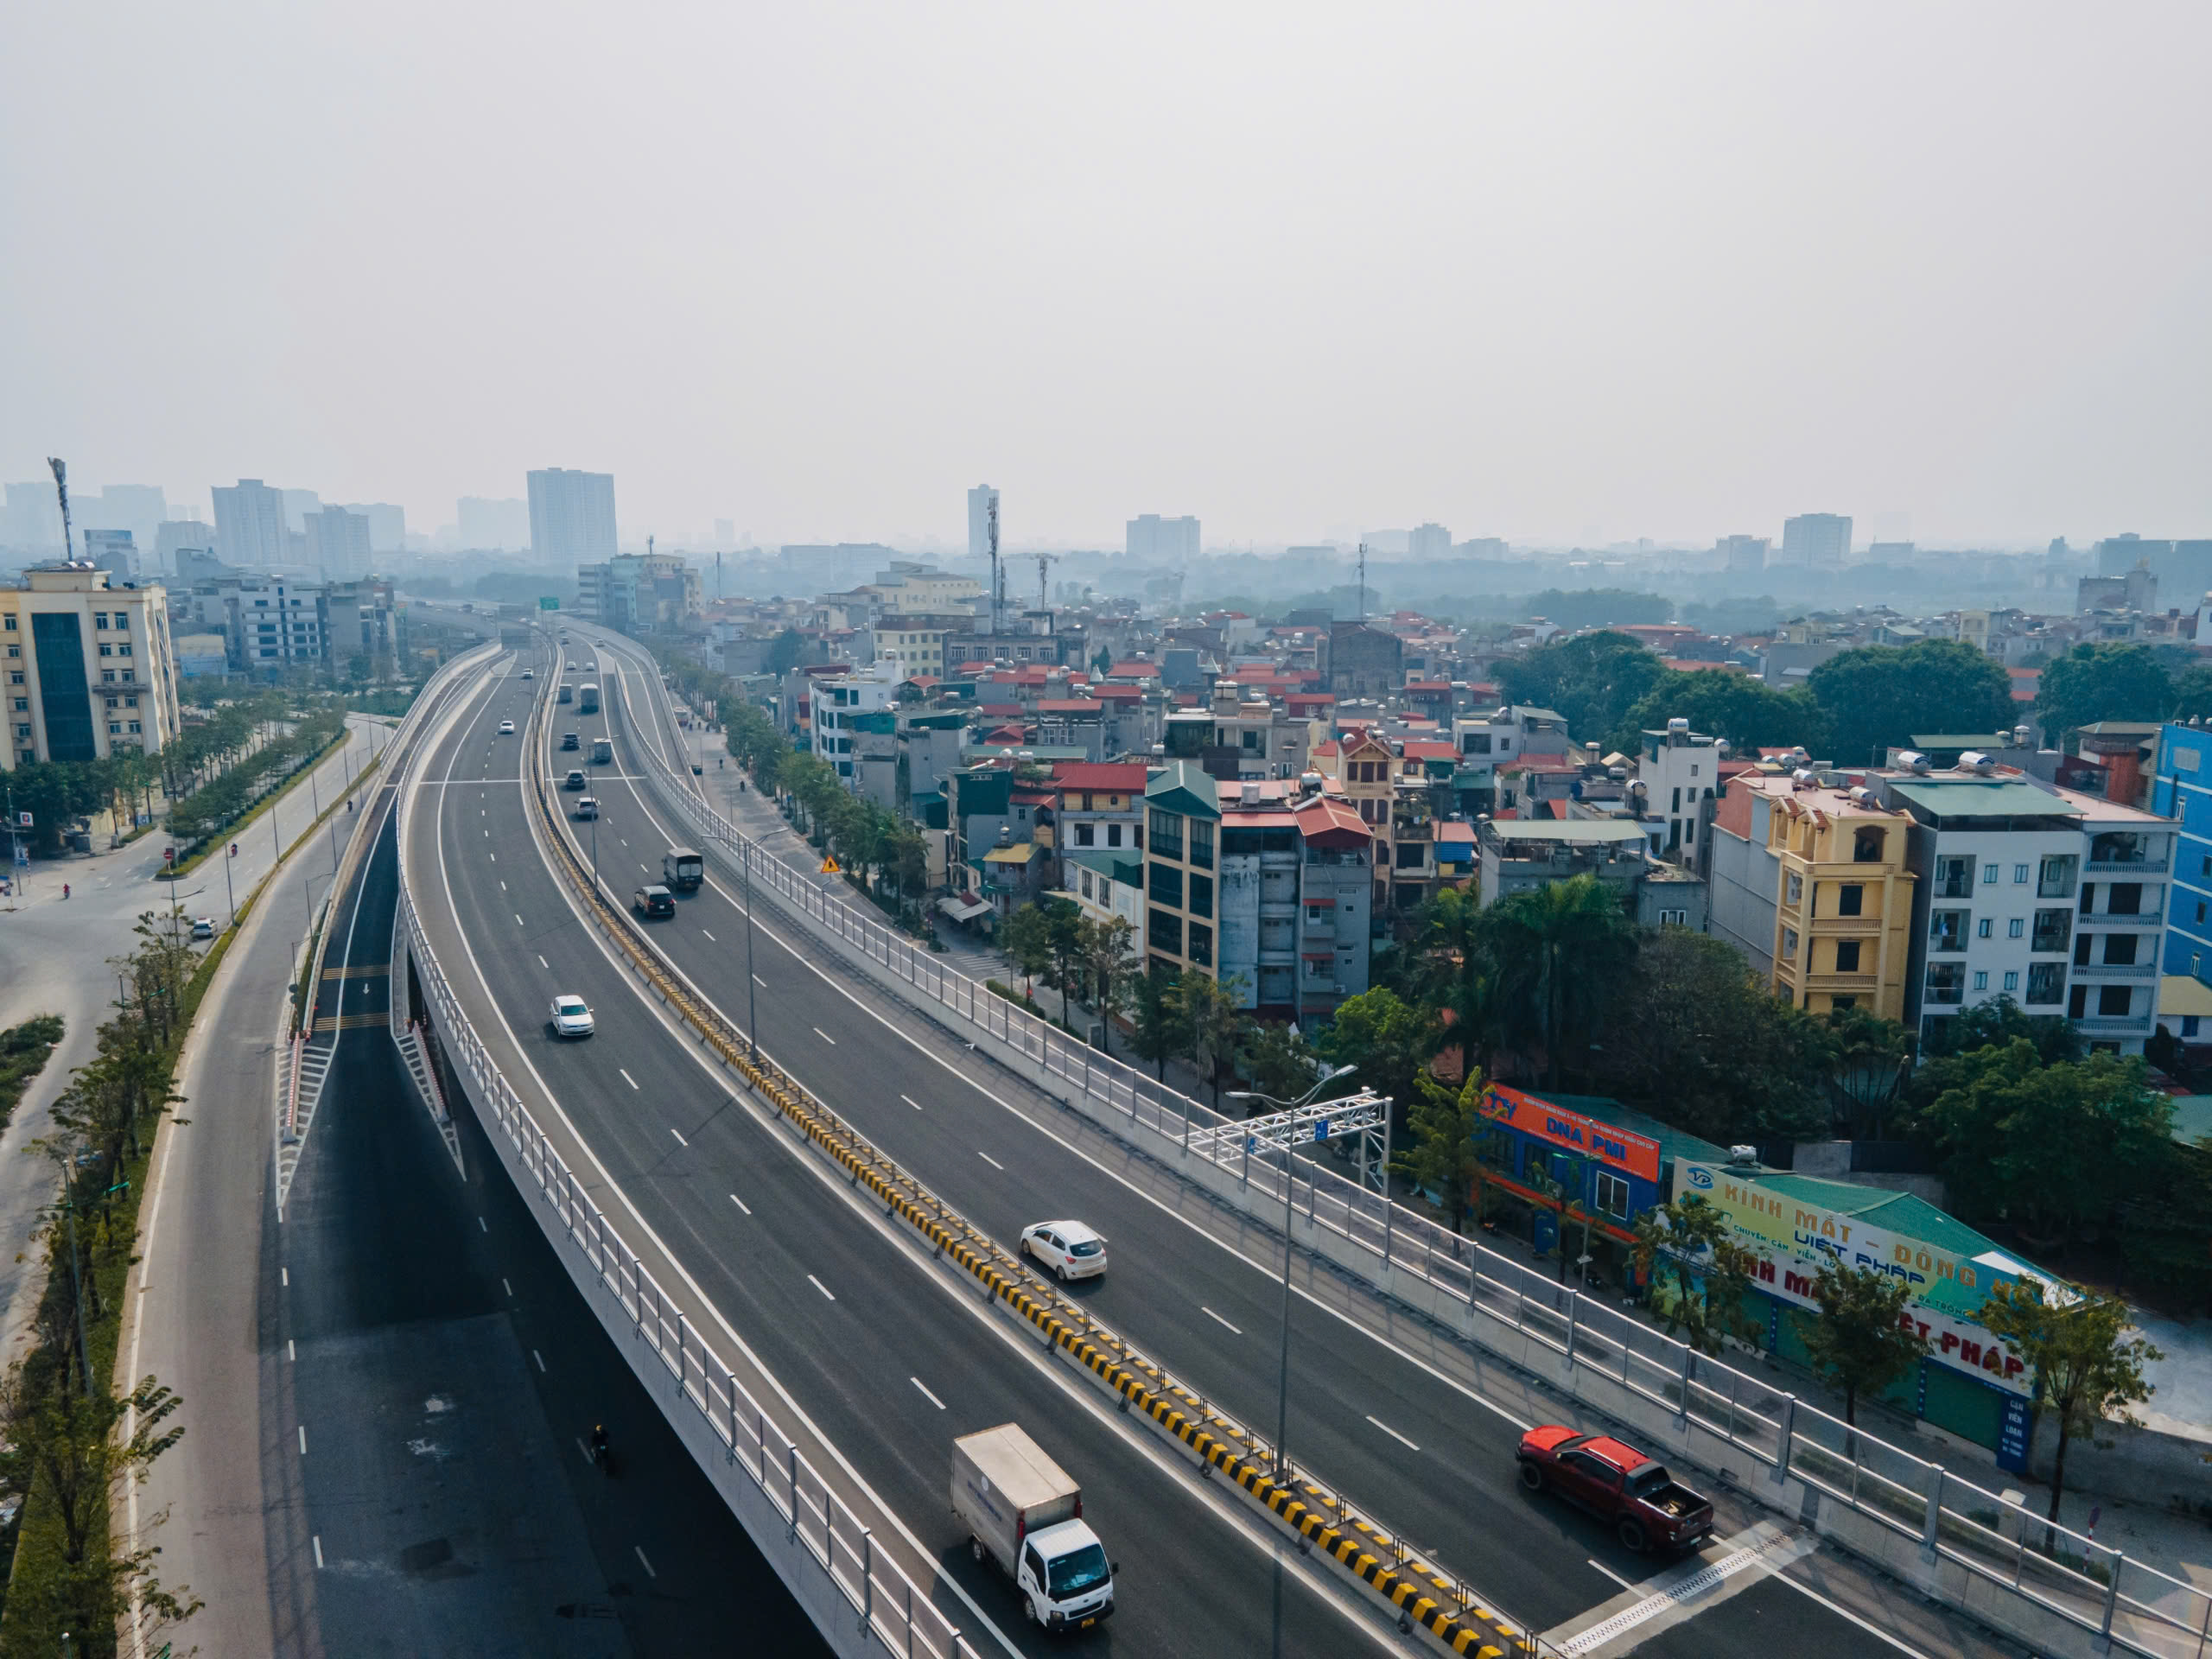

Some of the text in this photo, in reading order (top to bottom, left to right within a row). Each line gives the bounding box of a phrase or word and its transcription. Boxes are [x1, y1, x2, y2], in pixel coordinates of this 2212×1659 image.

[1547, 1116, 1583, 1144] DNA
[1592, 1133, 1627, 1161] PMI
[1725, 1183, 1783, 1218] KÍNH
